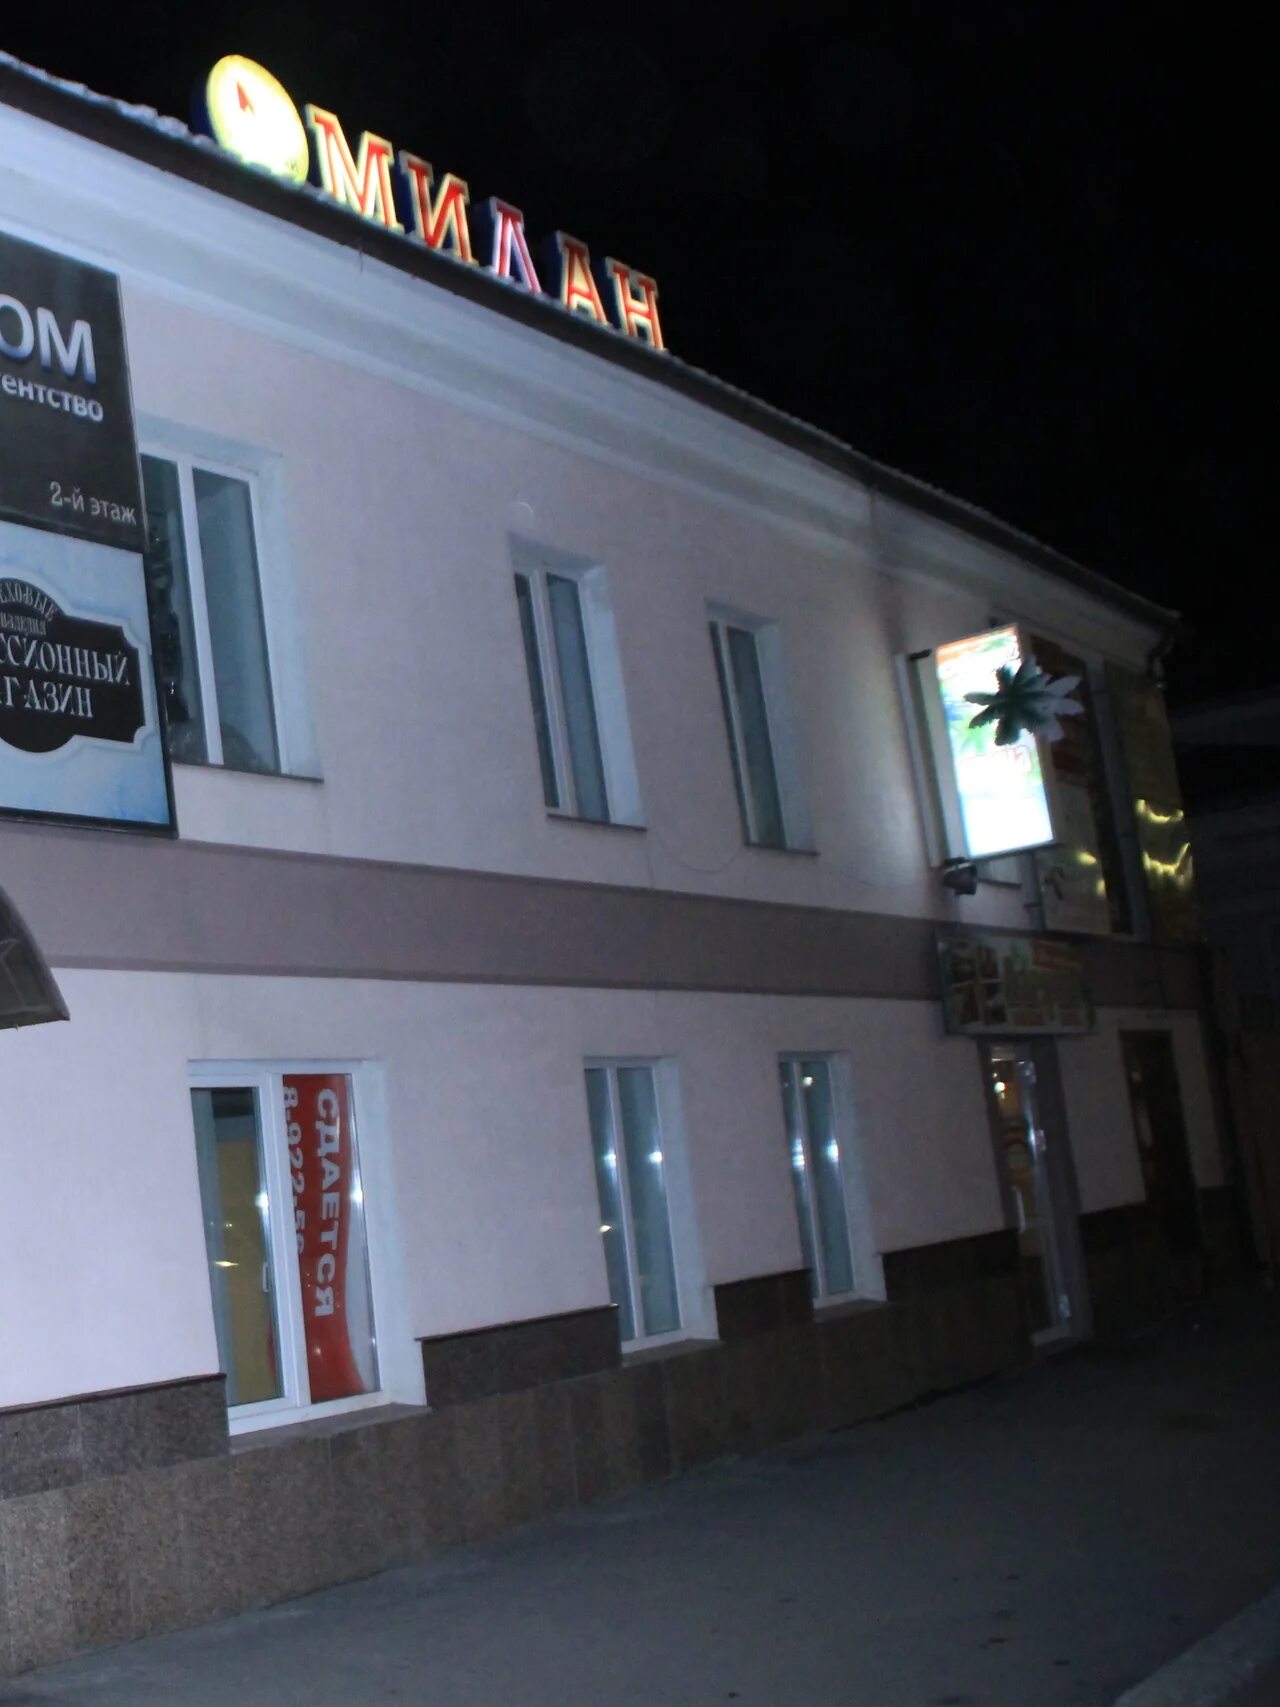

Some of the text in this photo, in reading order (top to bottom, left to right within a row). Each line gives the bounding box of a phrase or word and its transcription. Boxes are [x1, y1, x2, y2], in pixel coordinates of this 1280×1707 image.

[305, 103, 668, 351] МИЛАН
[50, 480, 137, 526] 2-й этаж
[315, 1088, 341, 1317] СДАЕТСЯ
